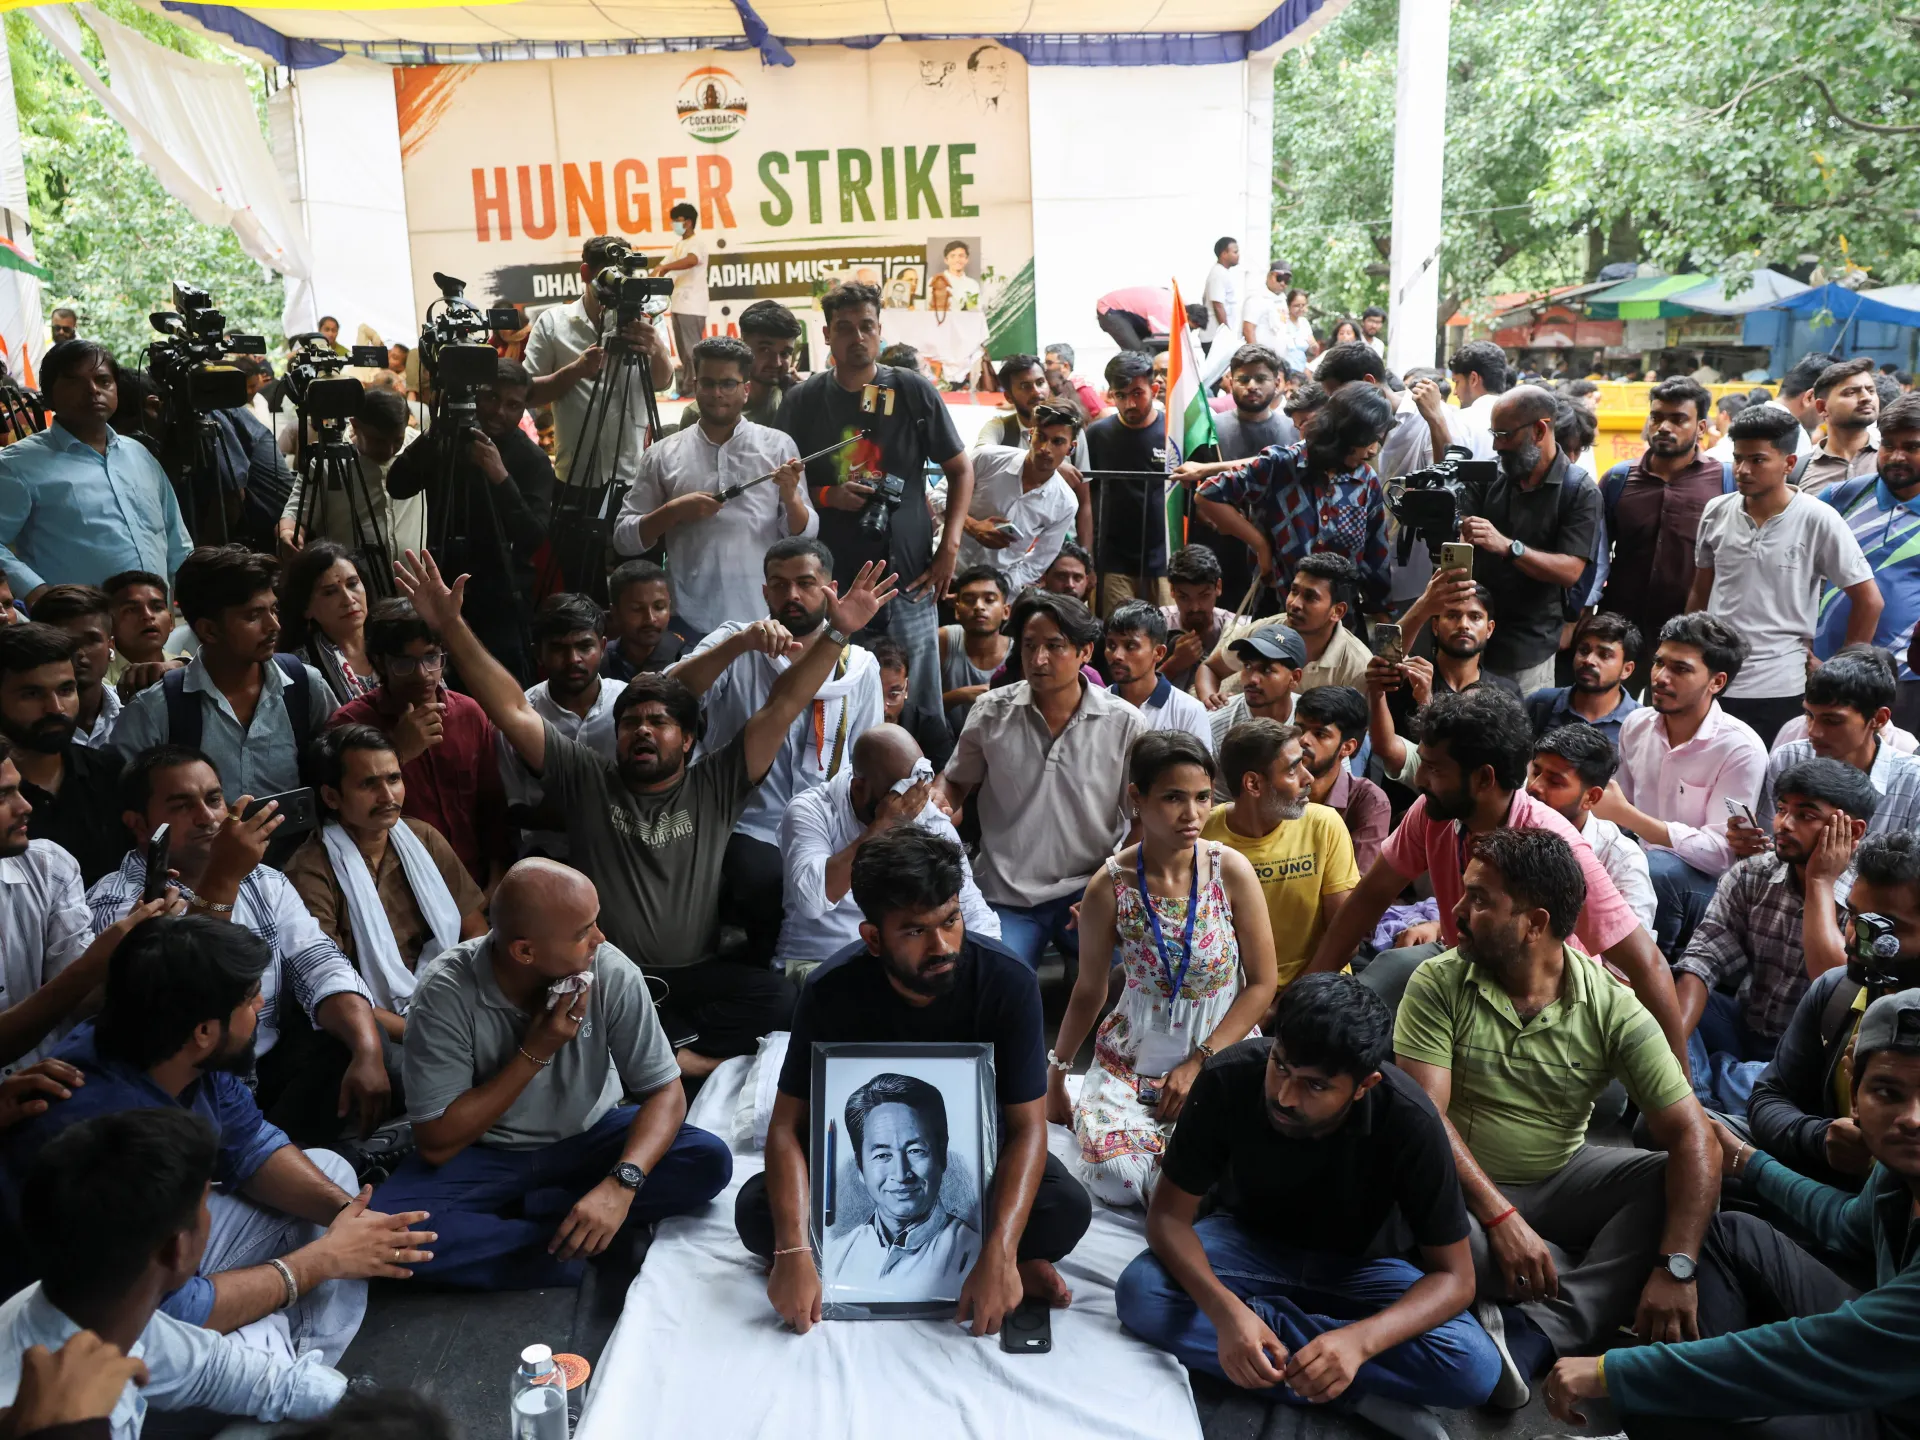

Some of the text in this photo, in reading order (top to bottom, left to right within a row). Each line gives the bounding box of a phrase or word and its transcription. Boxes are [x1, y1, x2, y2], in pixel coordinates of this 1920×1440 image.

[690, 114, 738, 126] COCKROACH
[471, 143, 980, 242] HUNGER STRIKE
[706, 261, 780, 288] ADHAN
[642, 822, 693, 846] SURFING
[1279, 860, 1312, 876] UNO
